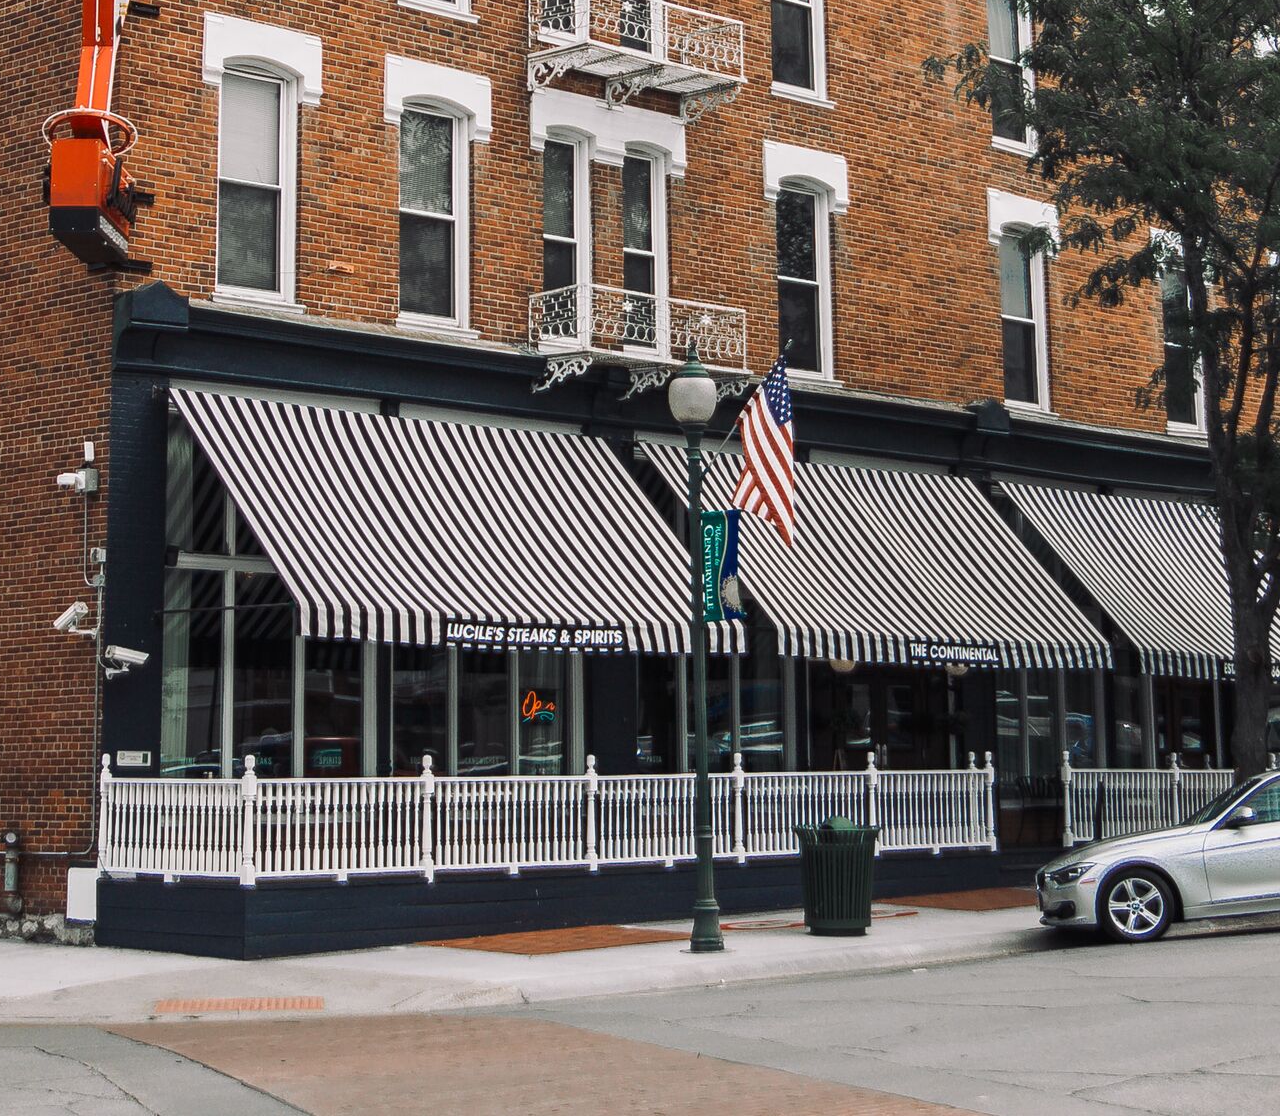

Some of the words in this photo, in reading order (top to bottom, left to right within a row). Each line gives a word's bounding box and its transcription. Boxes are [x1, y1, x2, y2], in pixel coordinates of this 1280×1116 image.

[447, 623, 505, 642] LUCILE'S
[506, 627, 557, 644] STEAKS
[559, 629, 570, 644] &
[574, 629, 623, 645] SPIRITS
[910, 643, 927, 657] THE
[929, 645, 999, 661] CONTINENTAL
[522, 690, 556, 719] Opn
[318, 756, 342, 766] SPIRITS
